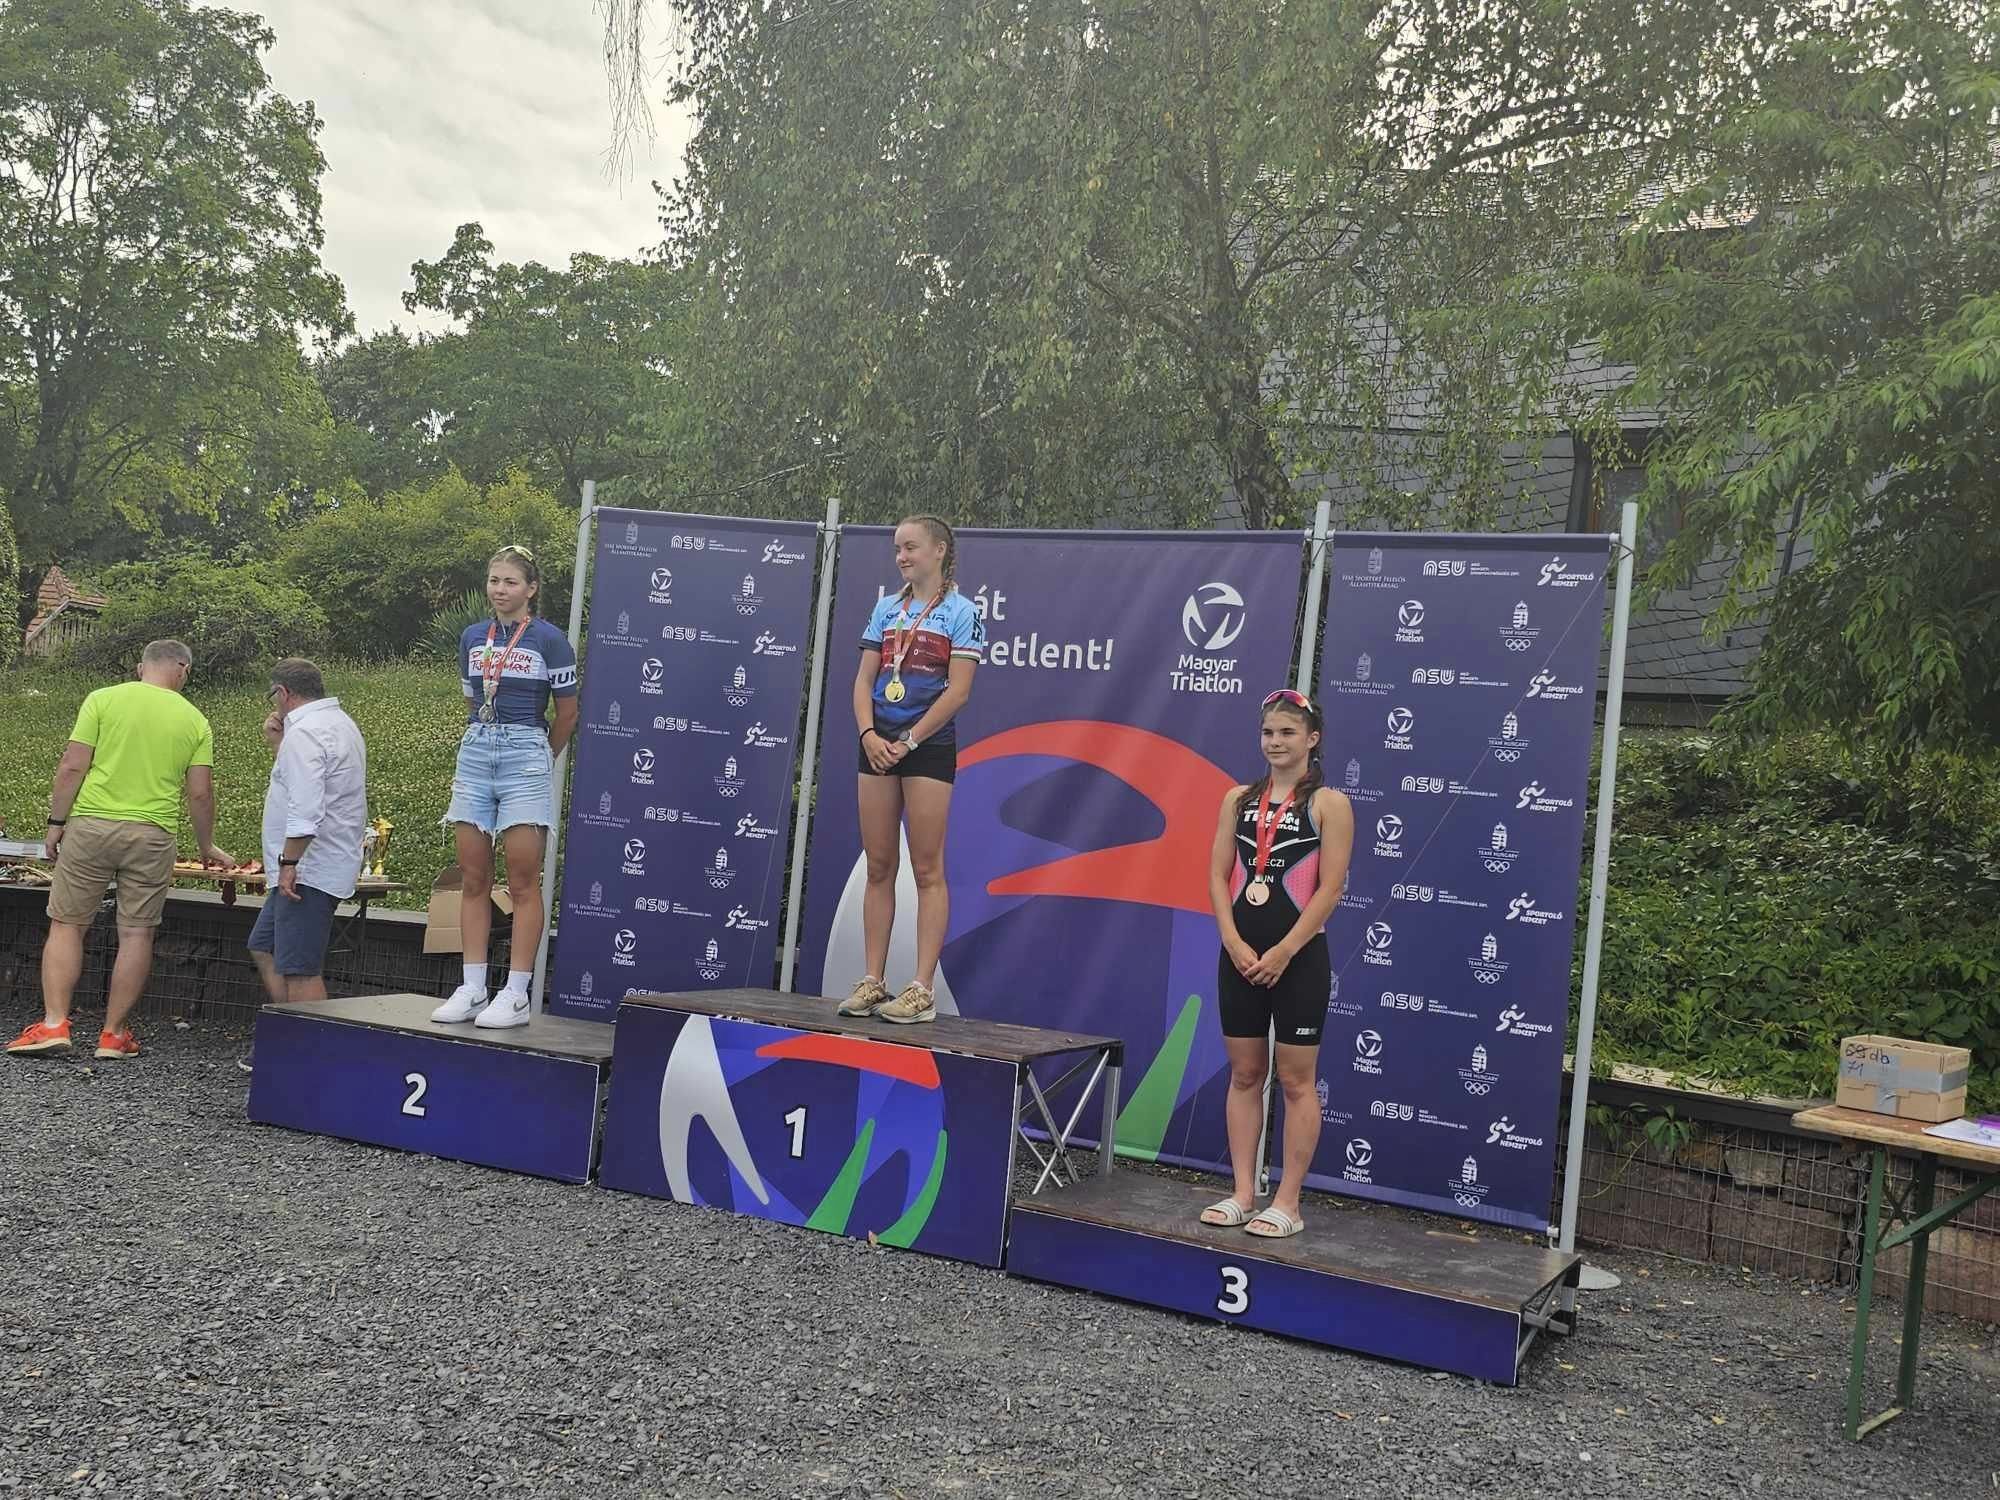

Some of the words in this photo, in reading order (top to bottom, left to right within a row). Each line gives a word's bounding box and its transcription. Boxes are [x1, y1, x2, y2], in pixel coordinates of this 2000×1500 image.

[651, 590, 670, 598] Magyar
[648, 596, 672, 604] Triatlon
[1398, 627, 1421, 636] Magyar
[1395, 633, 1424, 642] Triatlon
[979, 632, 1114, 670] etlent!
[1178, 654, 1237, 674] Magyar
[1170, 672, 1242, 693] Triatlon
[640, 686, 663, 694] Triatlon
[1387, 735, 1410, 743] Magyar
[1384, 741, 1413, 750] Triatlon
[631, 776, 654, 784] Triatlon
[1377, 842, 1400, 850] Magyar
[1373, 848, 1402, 858] Triatlon
[622, 867, 644, 876] Triatlon
[1366, 949, 1390, 957] Magyar
[612, 957, 635, 966] Triatlon
[1363, 955, 1392, 965] Triatlon
[1356, 1057, 1380, 1066] Magyar
[1353, 1063, 1382, 1074] Triatlon
[403, 1073, 426, 1116] 2
[785, 1108, 806, 1156] 1
[1346, 1165, 1370, 1175] Magyar
[1343, 1171, 1371, 1184] Triatlon
[1218, 1267, 1248, 1313] 3
